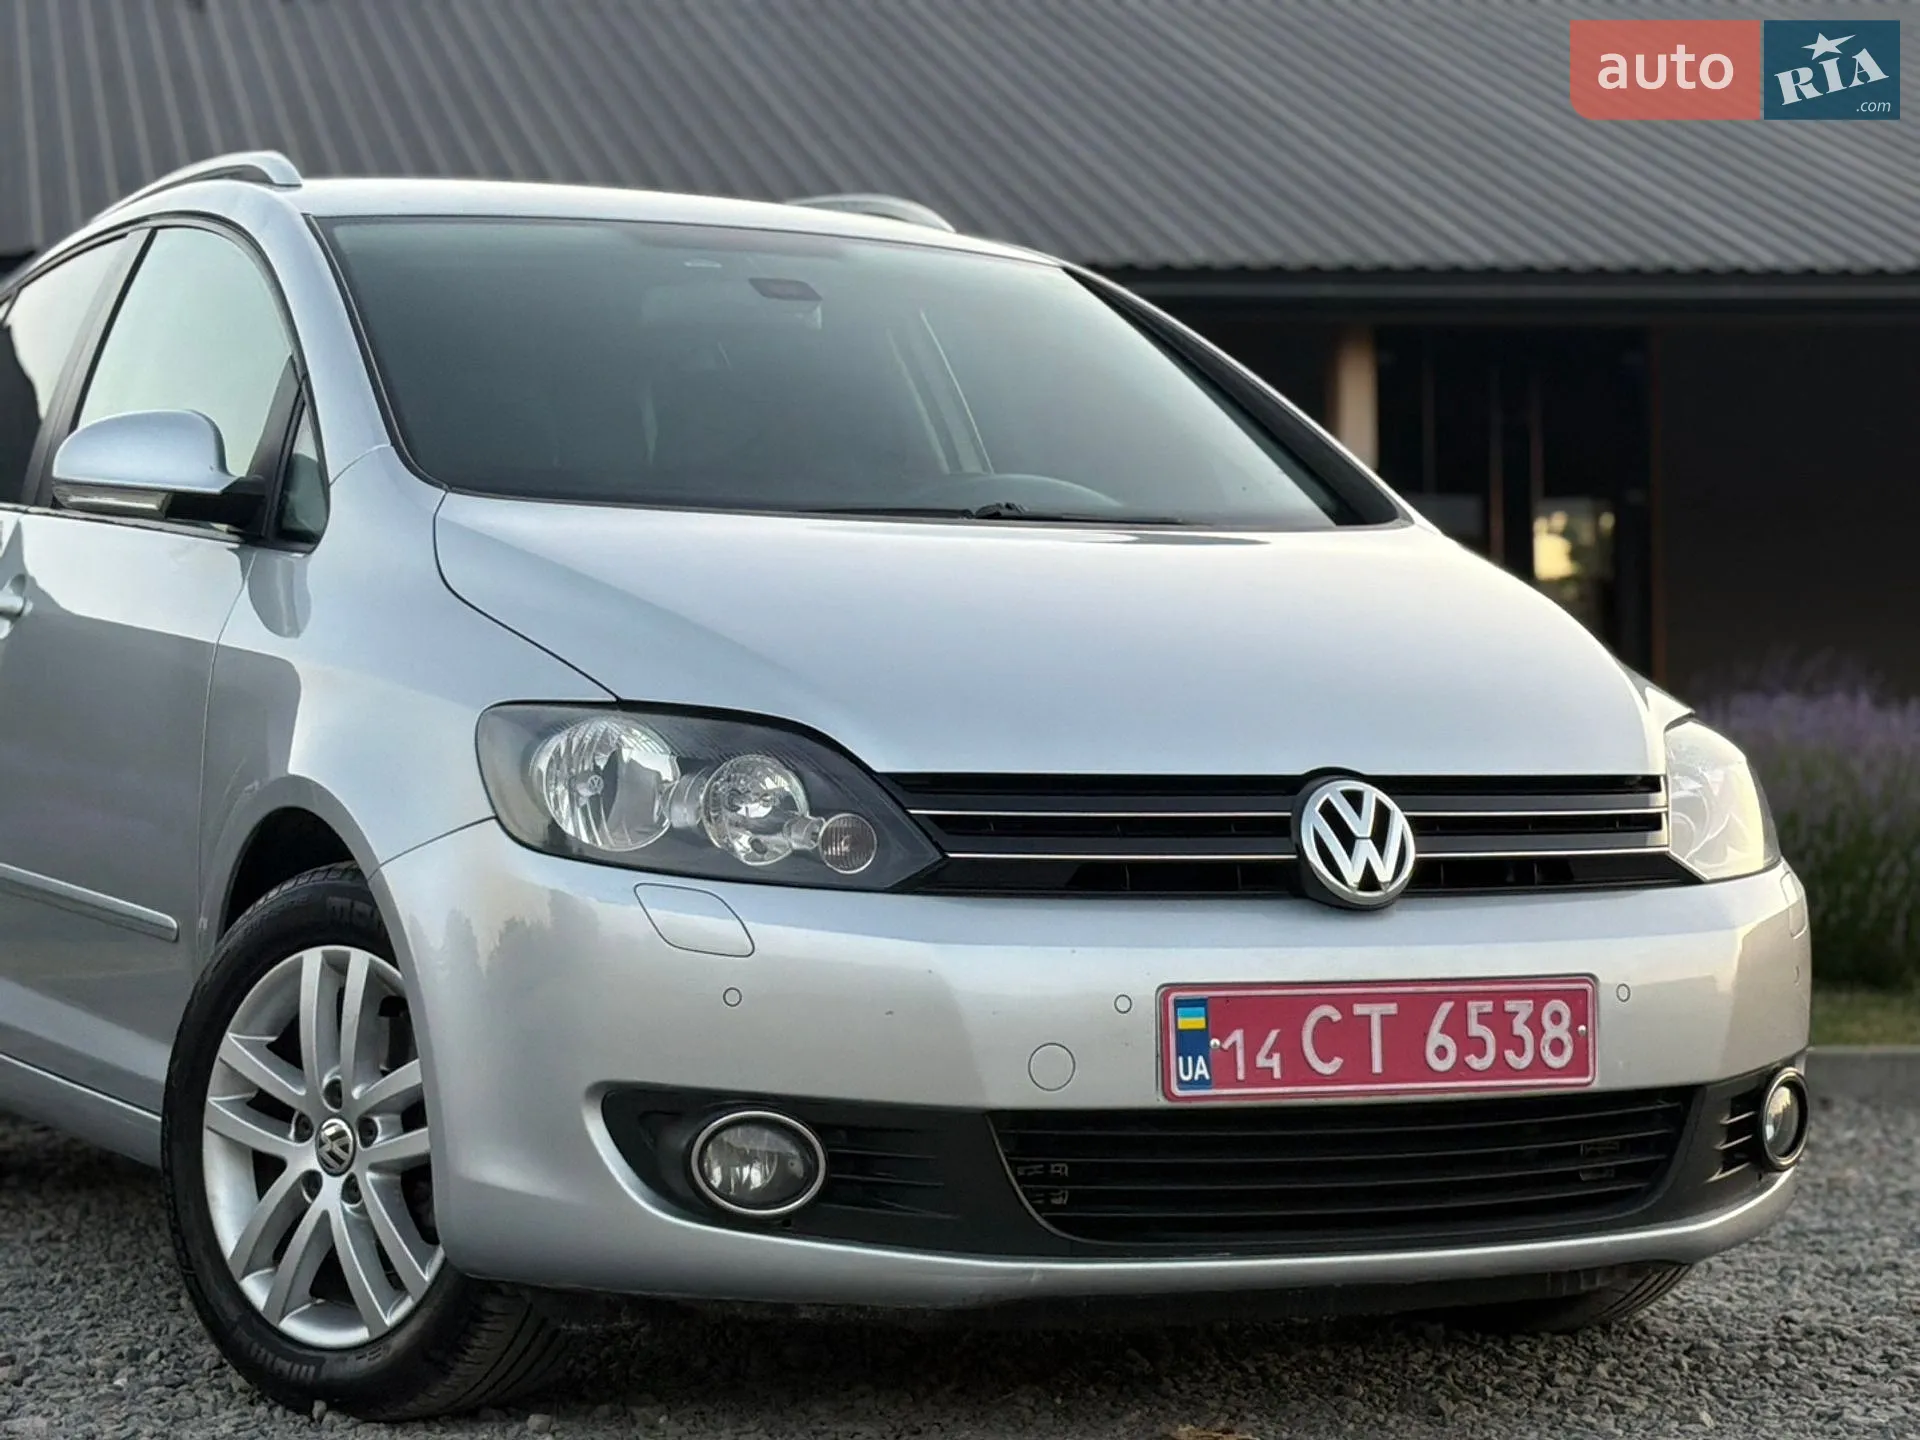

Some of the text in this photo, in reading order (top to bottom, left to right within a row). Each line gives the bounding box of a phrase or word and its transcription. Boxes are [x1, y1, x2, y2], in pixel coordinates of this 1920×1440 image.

[1303, 782, 1412, 898] VW
[1178, 1054, 1211, 1082] UA
[1221, 999, 1575, 1082] 14 CT 6538
